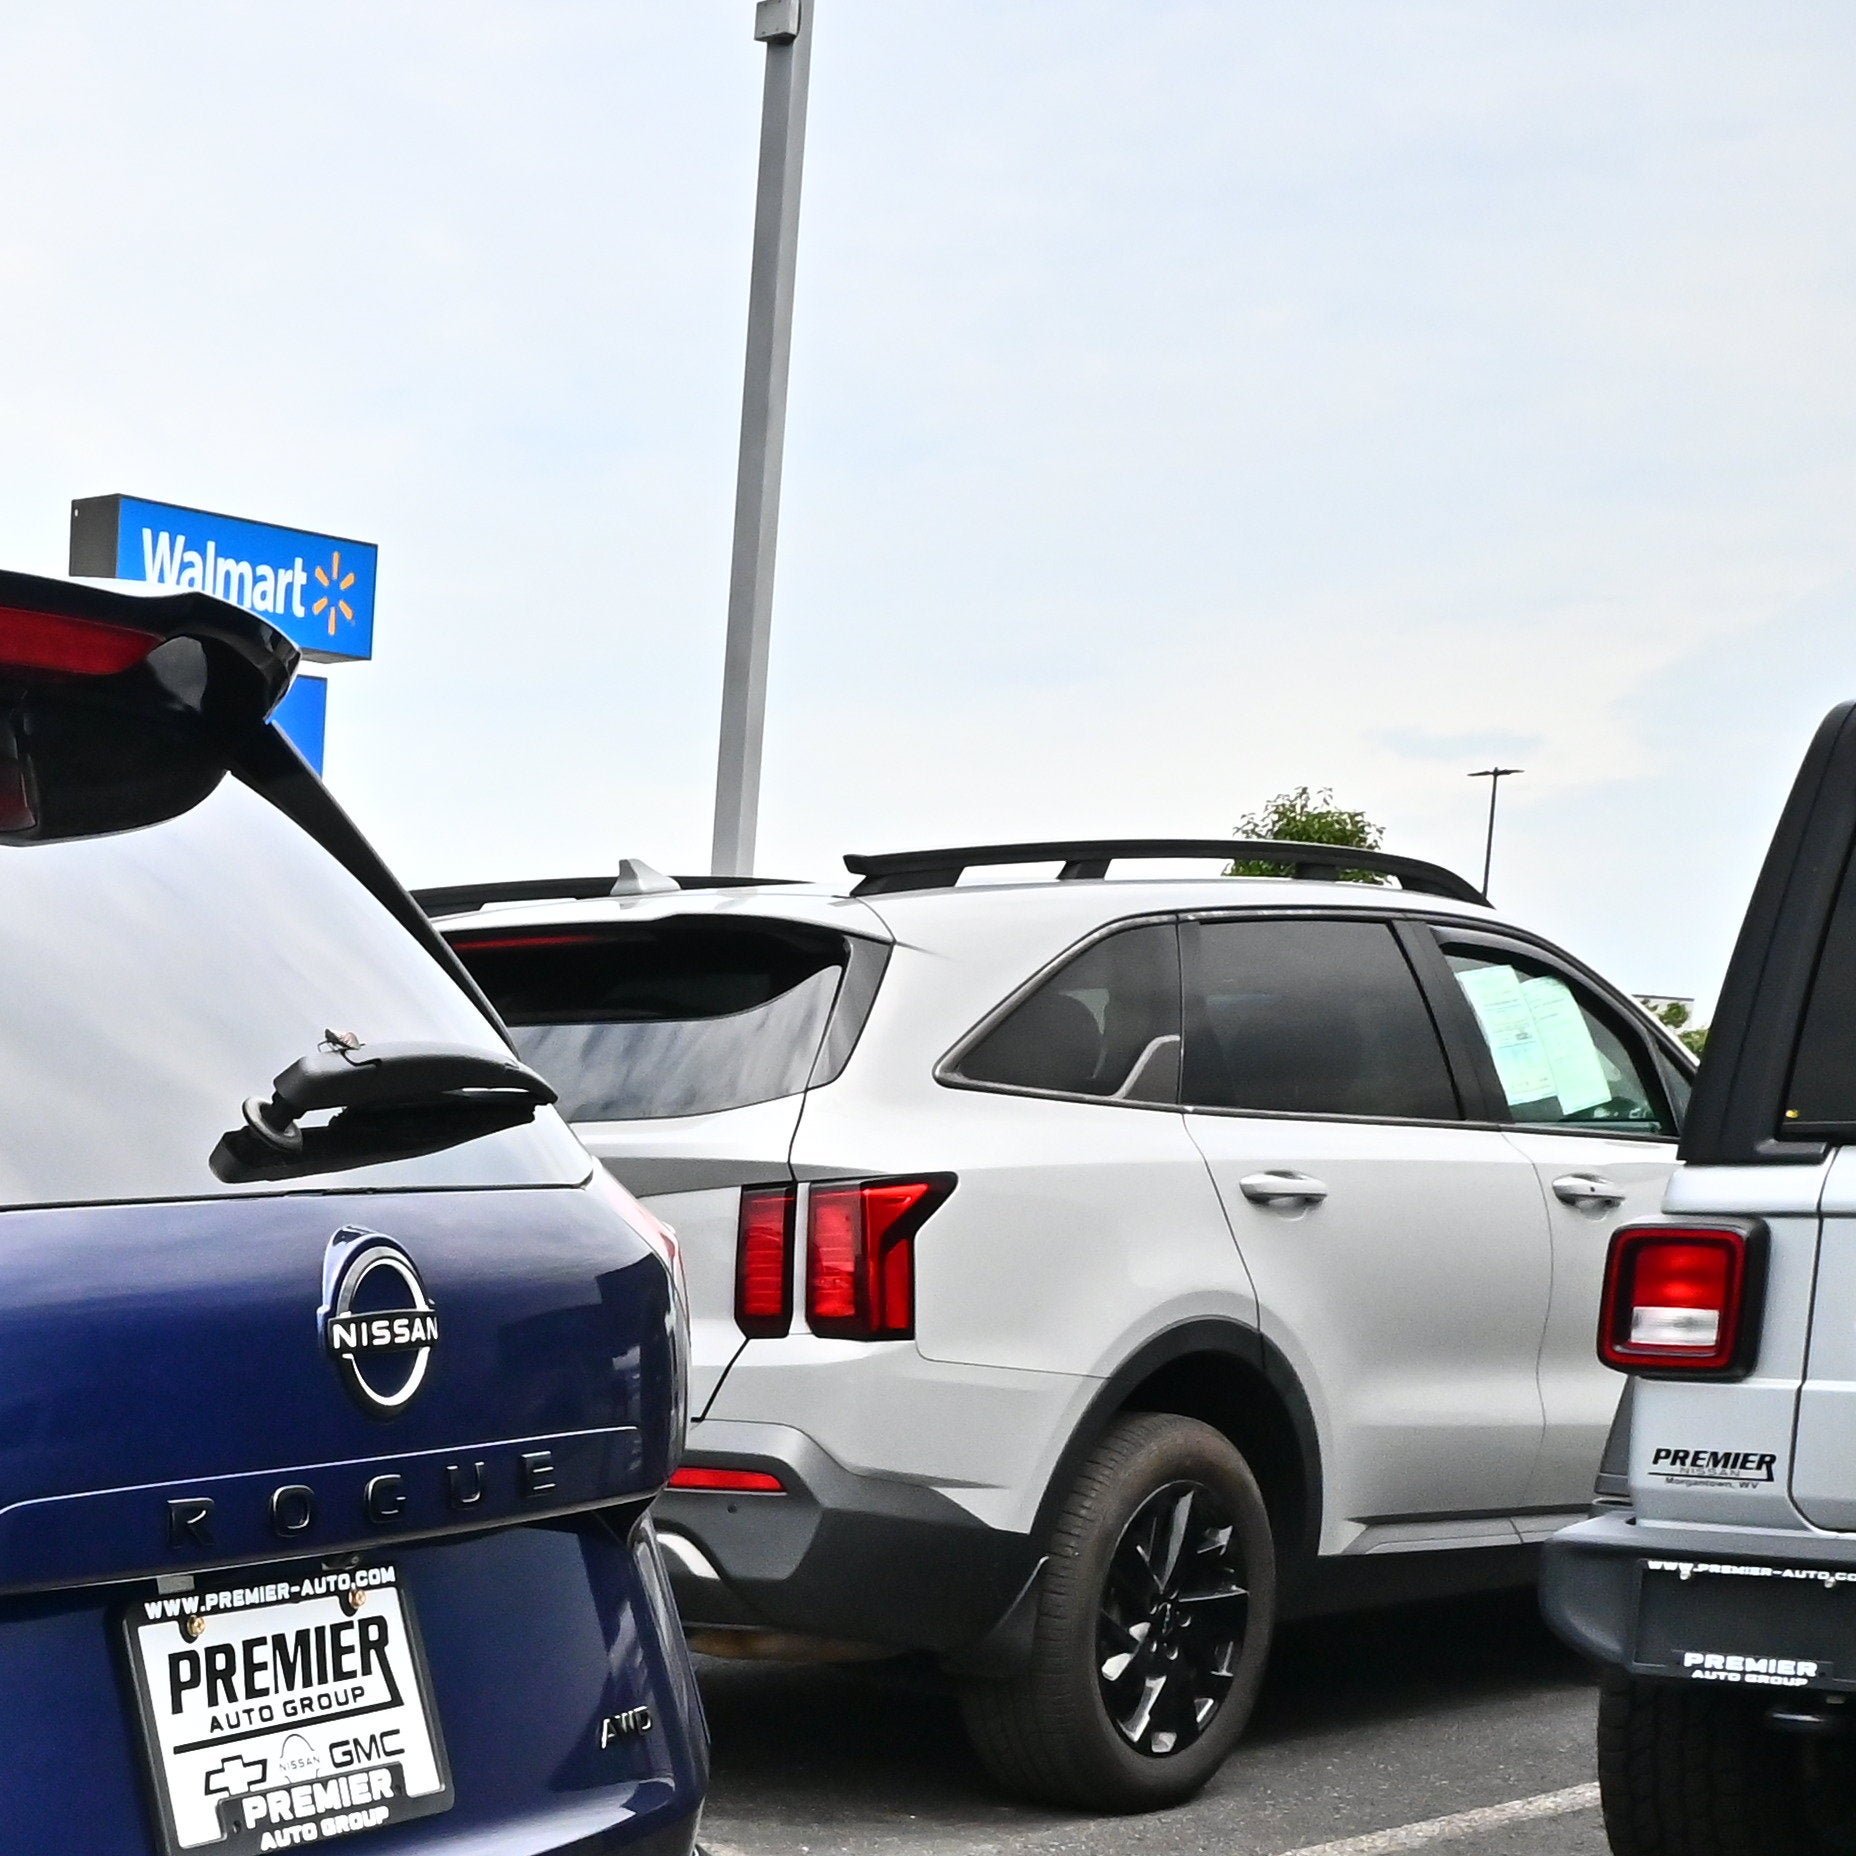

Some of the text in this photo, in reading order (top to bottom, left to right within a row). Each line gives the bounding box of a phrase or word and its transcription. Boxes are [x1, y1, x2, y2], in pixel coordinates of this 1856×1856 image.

[142, 527, 307, 618] Walmart
[332, 1314, 438, 1350] NISSAN
[1652, 1448, 1777, 1482] PREMIER
[1739, 1481, 1759, 1489] WV
[167, 1450, 557, 1549] ROGUE
[144, 1566, 397, 1620] WWW.PREMIER-AUTO.COM
[168, 1615, 403, 1714] PREMIER
[1684, 1652, 1818, 1677] PREMIER
[1691, 1669, 1808, 1686] AUTO GROUP
[209, 1686, 365, 1733] AUTO GROUP
[601, 1705, 652, 1749] AWD
[329, 1729, 405, 1768] GMC
[242, 1768, 394, 1829] PREMIER
[260, 1806, 390, 1851] AUTO GROUP
